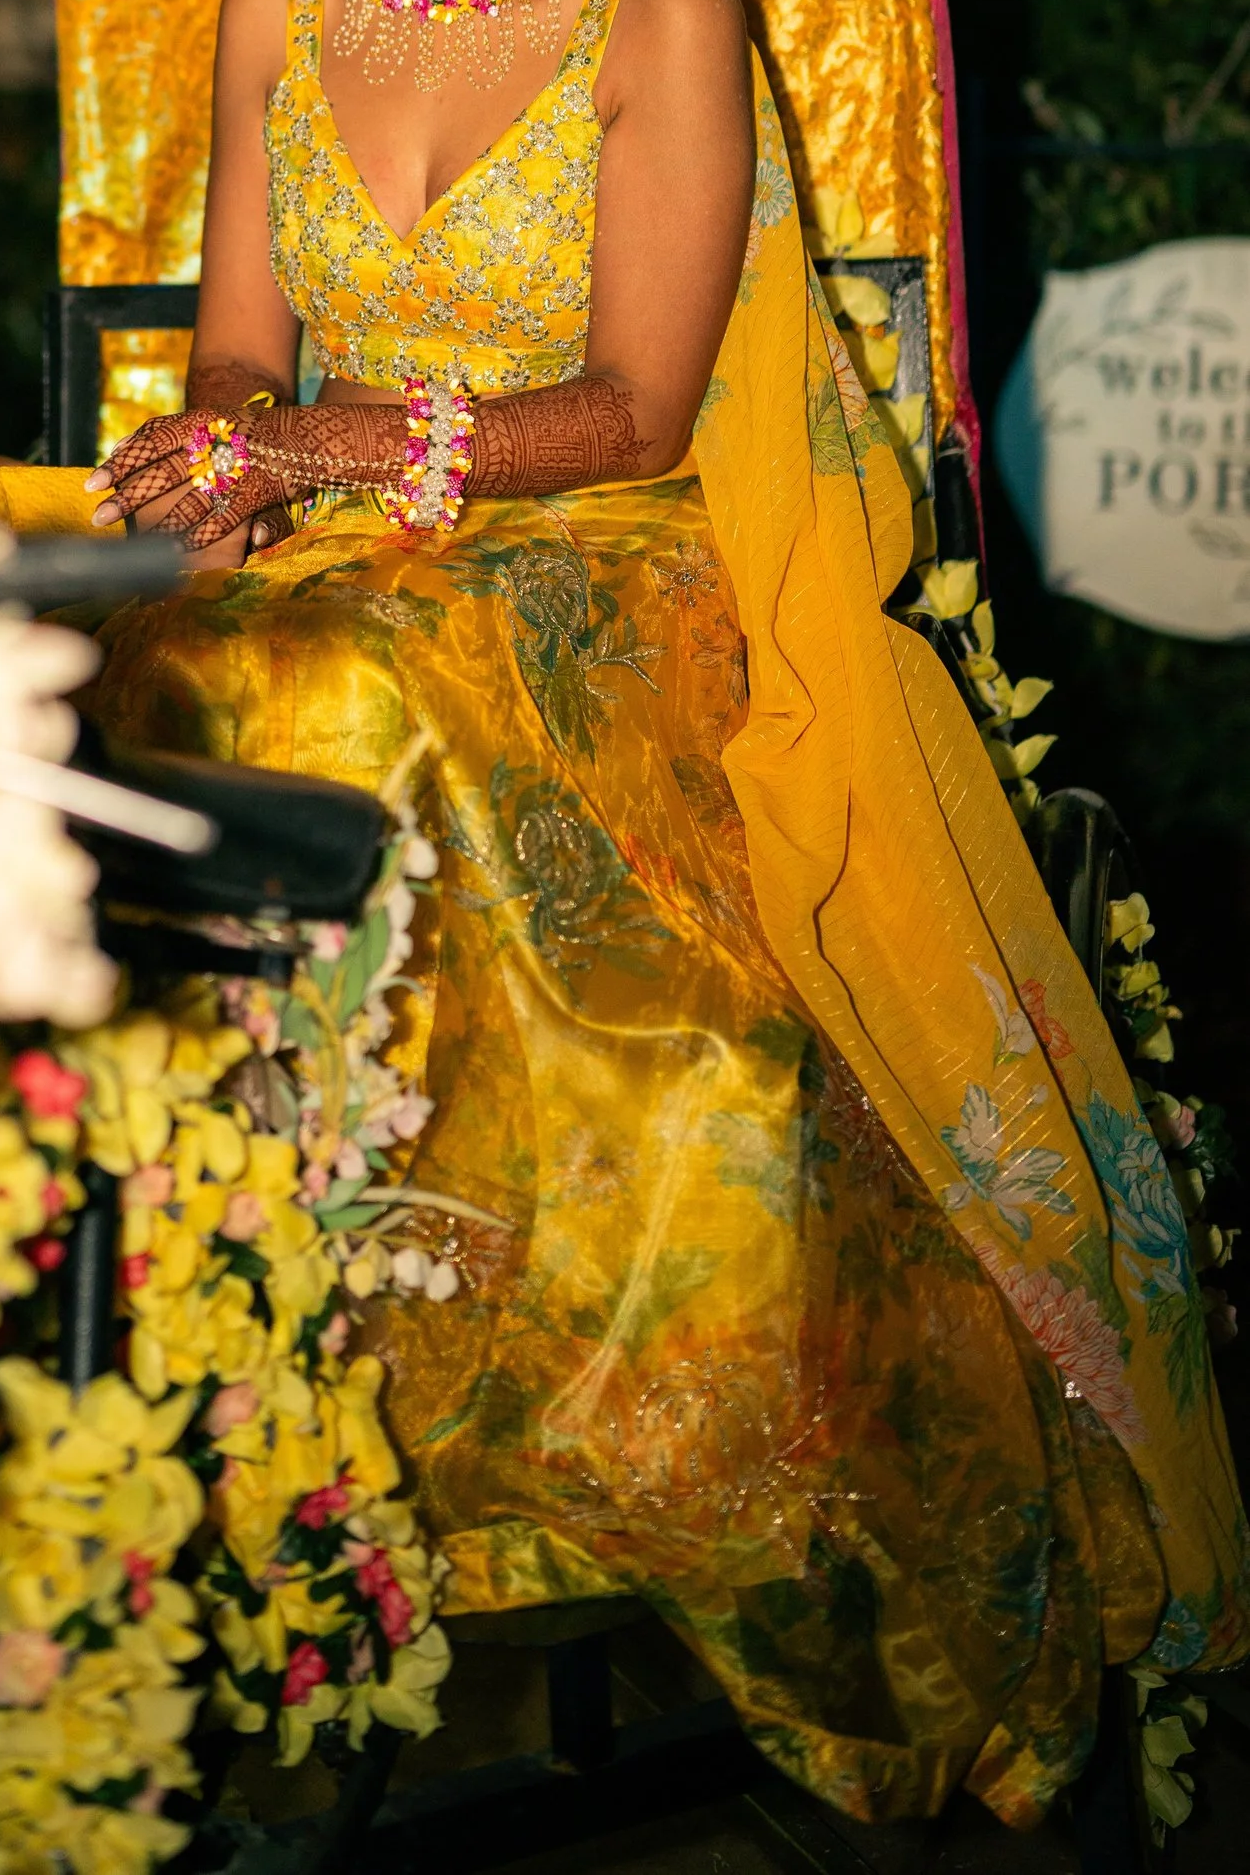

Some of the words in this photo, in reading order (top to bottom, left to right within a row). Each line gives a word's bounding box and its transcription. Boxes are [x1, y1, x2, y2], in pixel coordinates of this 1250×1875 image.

[1096, 344, 1250, 401] welc
[1157, 408, 1207, 447] to
[1221, 410, 1250, 446] t
